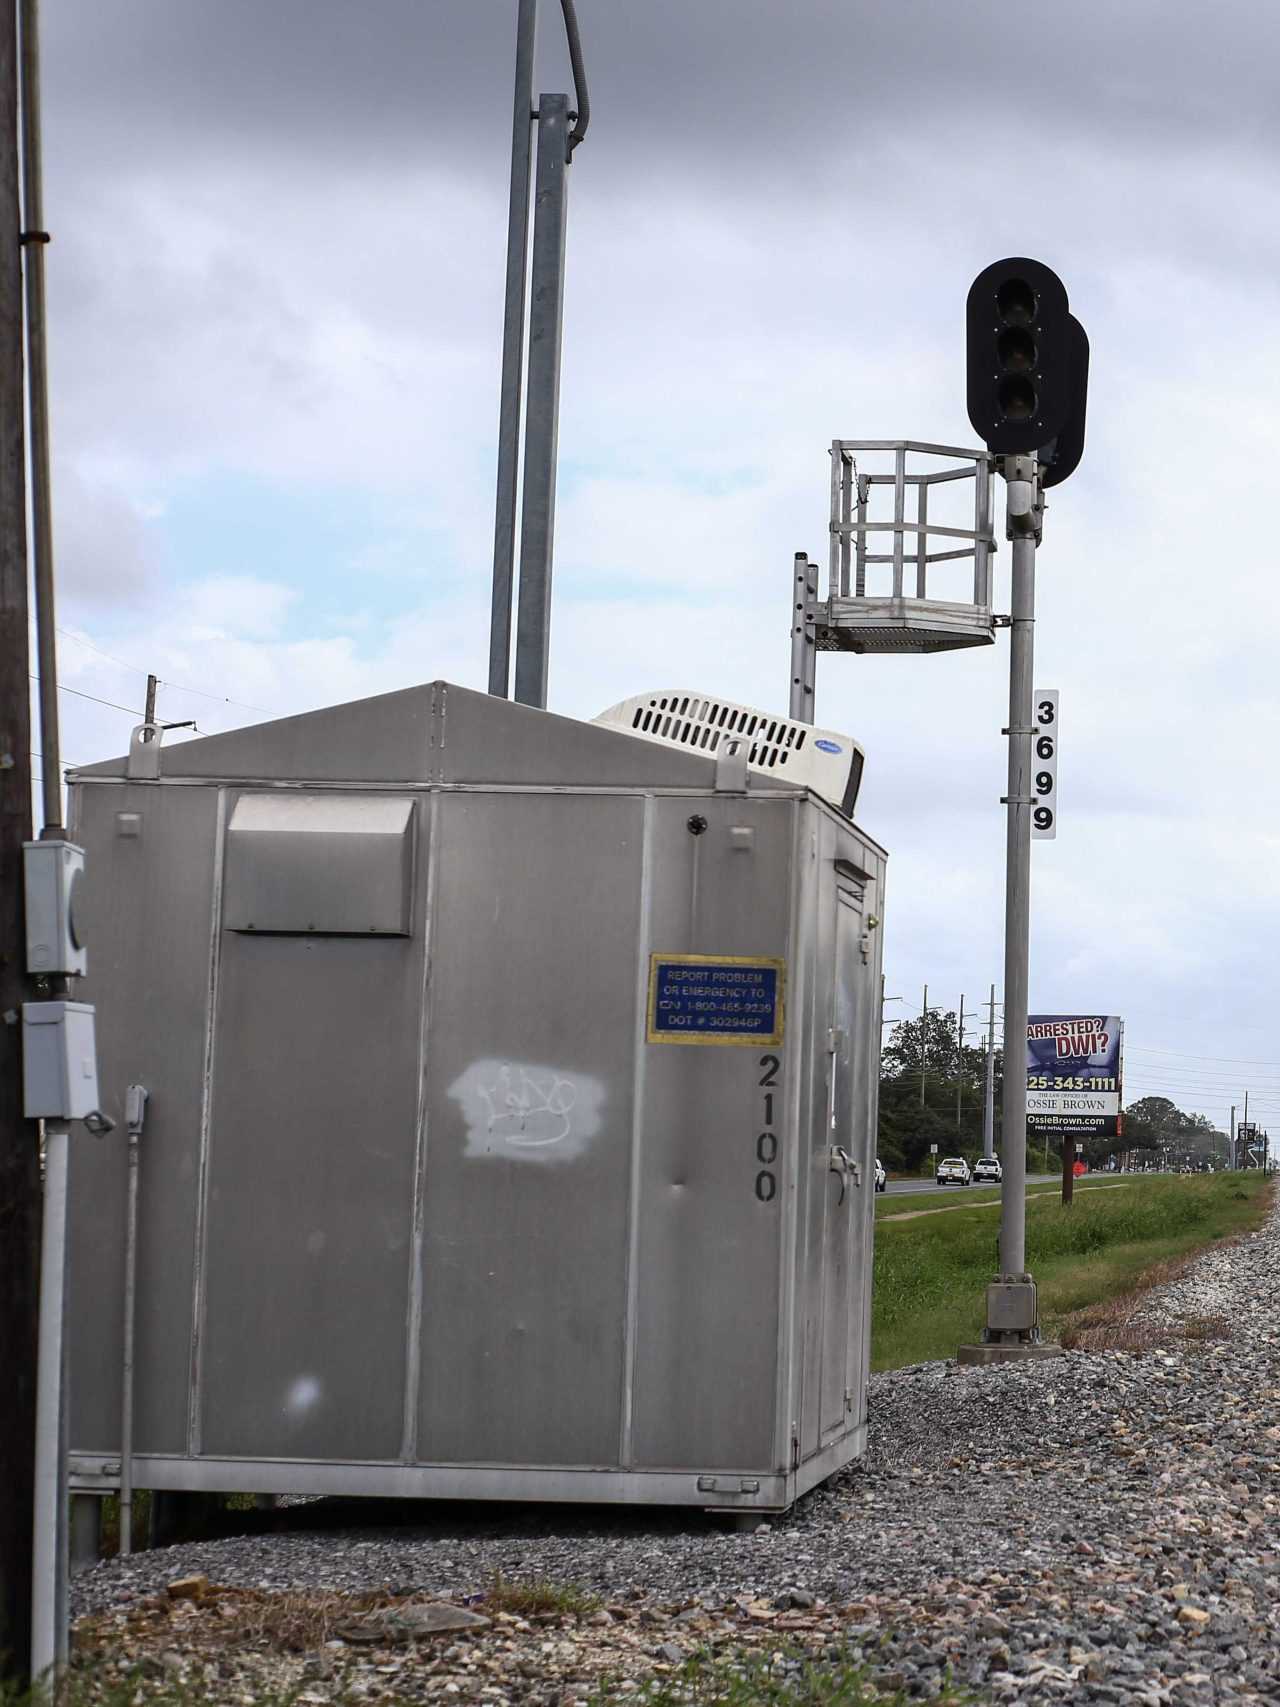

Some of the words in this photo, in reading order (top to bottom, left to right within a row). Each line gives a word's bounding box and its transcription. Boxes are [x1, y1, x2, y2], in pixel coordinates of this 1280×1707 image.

[1033, 701, 1054, 830] 3699
[667, 970, 709, 982] REPORT
[712, 972, 763, 983] PROBLEM
[663, 985, 680, 996] OR
[682, 985, 747, 998] EMERGENCY
[750, 988, 766, 998] TO
[668, 1015, 693, 1025] DOT
[1026, 1018, 1102, 1039] ARRESTED?
[1056, 1033, 1109, 1057] DWI?
[1027, 1076, 1116, 1090] 25-343-1111
[1027, 1099, 1057, 1109] OSSIE
[1063, 1100, 1105, 1110] BROWN
[1027, 1115, 1105, 1125] OssieBrown.com
[754, 1054, 780, 1203] 2100
